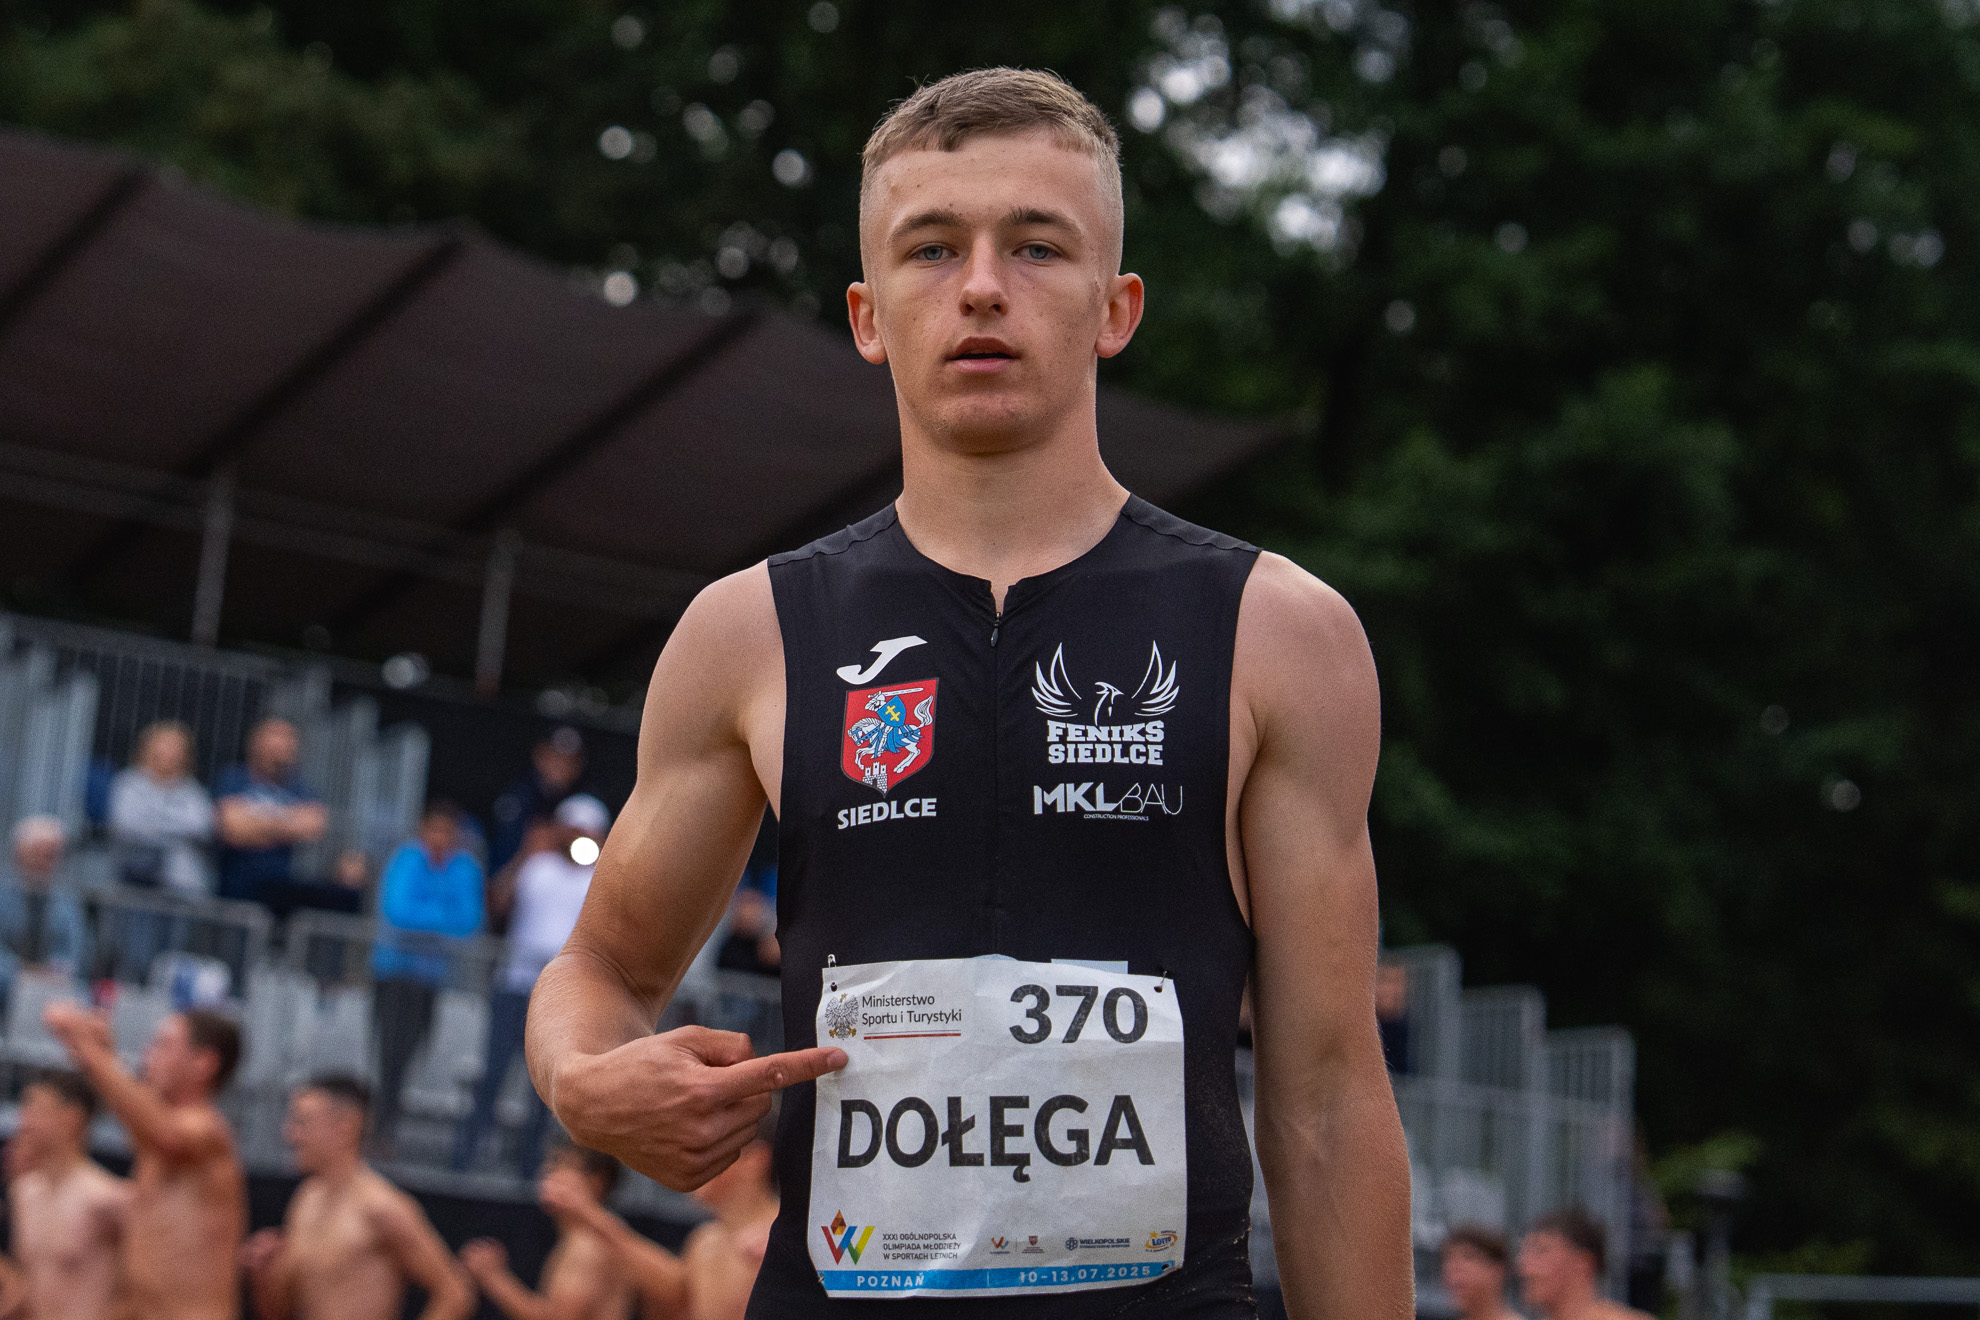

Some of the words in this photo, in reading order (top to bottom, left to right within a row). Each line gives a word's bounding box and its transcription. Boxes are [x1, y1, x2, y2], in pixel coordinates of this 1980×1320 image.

[1046, 719, 1165, 743] FENIKS
[1048, 743, 1164, 766] SIEDLCE
[837, 797, 938, 830] SIEDLCE
[862, 994, 935, 1008] Ministerstwo
[862, 1012, 897, 1027] Sportu
[900, 1011, 904, 1023] i
[907, 1009, 962, 1025] Turystyki
[1009, 983, 1148, 1044] 370
[837, 1094, 1156, 1183] DOŁĘGA
[883, 1233, 898, 1241] XXXI
[899, 1232, 957, 1241] OGÓLNOPOLSKA
[1079, 1237, 1130, 1245] WIELKOPOLSKIE
[883, 1243, 921, 1251] OLIMPIADA
[923, 1242, 961, 1250] MŁODZIEŻY
[891, 1252, 929, 1260] SPORTACH
[930, 1252, 958, 1260] LETNICH
[857, 1272, 925, 1287] POZNAŃ
